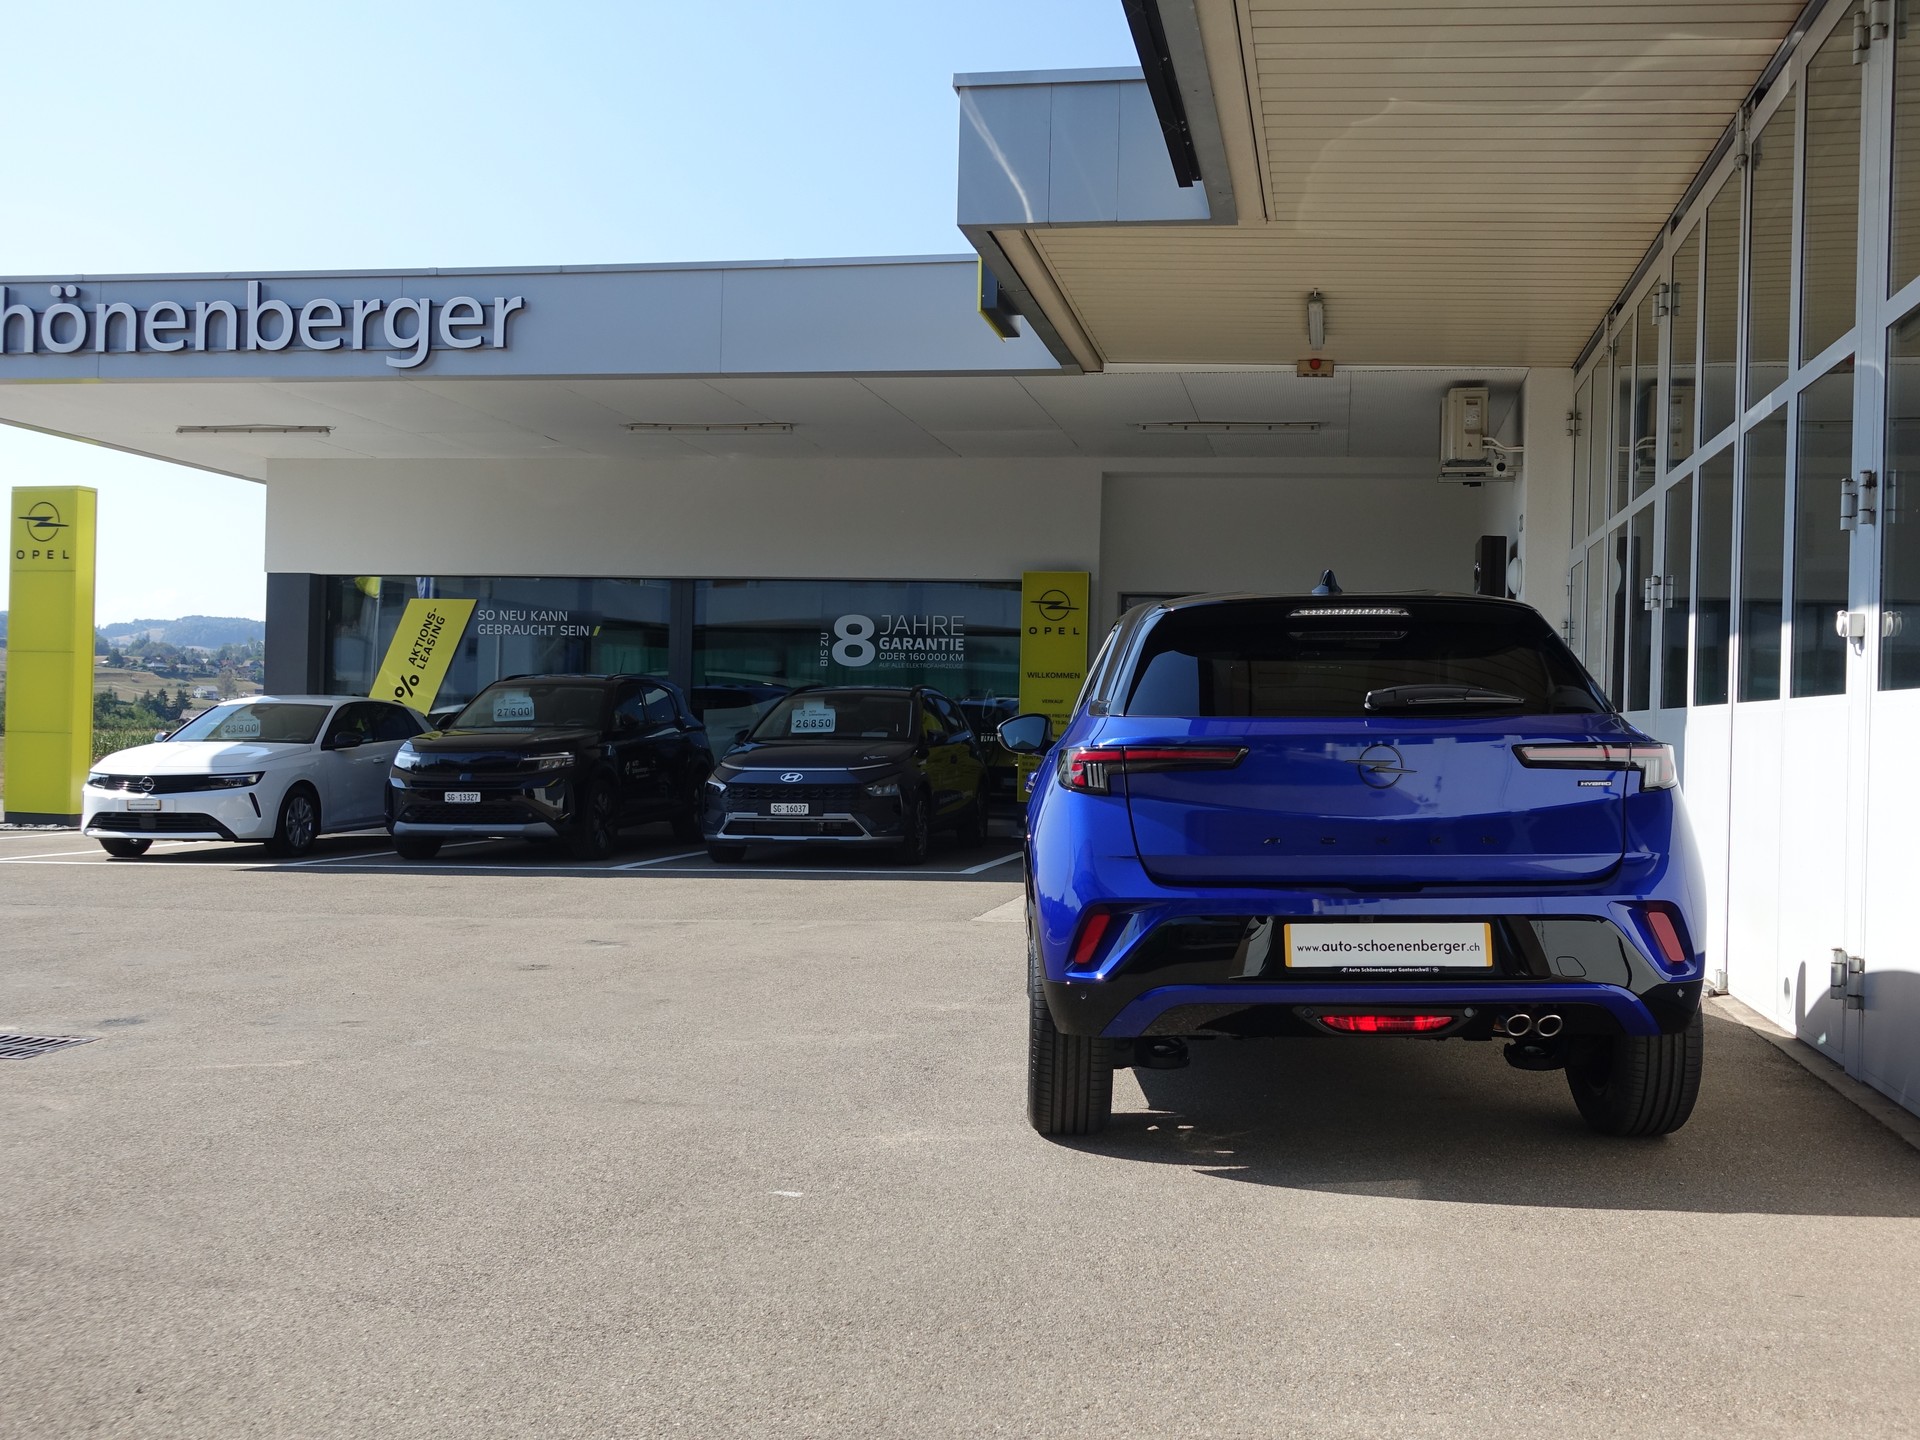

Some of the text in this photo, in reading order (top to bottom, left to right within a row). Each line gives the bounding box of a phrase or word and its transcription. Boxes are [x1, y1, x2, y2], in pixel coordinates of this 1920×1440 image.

[16, 550, 69, 560] OPEL
[477, 609, 568, 622] SO NEU KANN
[477, 624, 590, 637] GEBRAUCHT SEIN
[879, 614, 965, 636] JAHRE
[1028, 627, 1080, 635] OPEL
[408, 608, 437, 666] AKTIONS-
[417, 617, 446, 670] LEASING
[831, 614, 876, 667] 8
[879, 637, 965, 651] GARANTIE
[819, 632, 829, 667] BIS ZU
[879, 652, 906, 661] ODER
[949, 653, 964, 661] KM
[1297, 939, 1480, 955] www.auto-schoenenberger.ch
